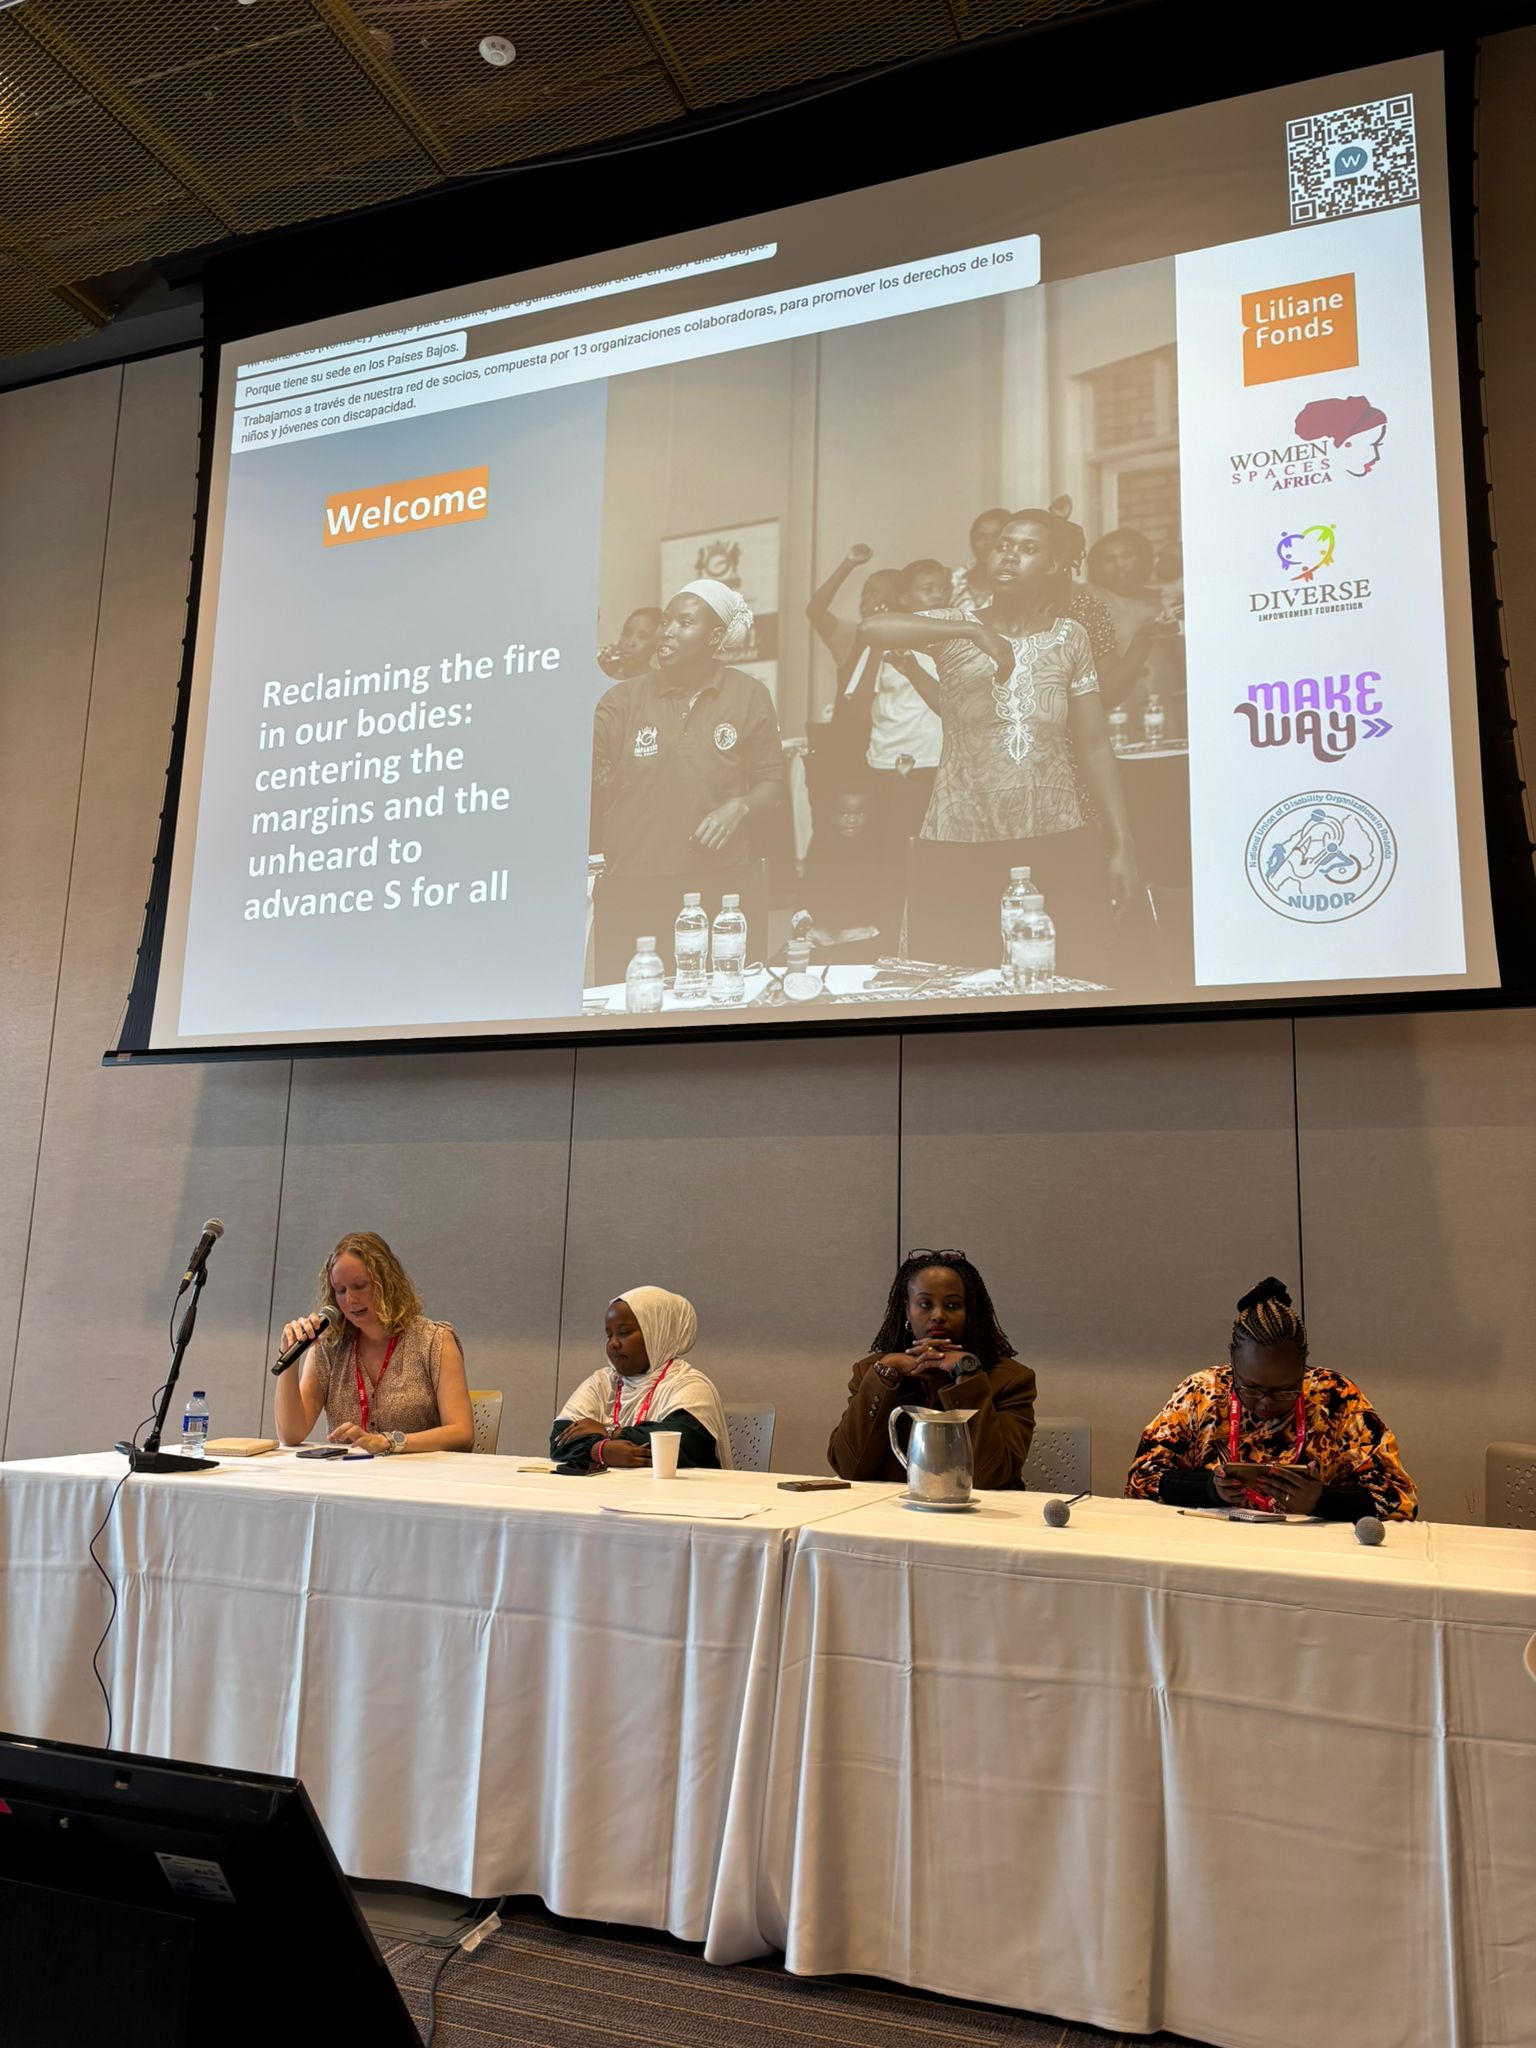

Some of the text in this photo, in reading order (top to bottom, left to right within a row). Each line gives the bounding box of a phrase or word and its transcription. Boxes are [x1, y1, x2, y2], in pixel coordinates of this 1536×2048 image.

[1255, 292, 1344, 324] Liliane
[243, 251, 1014, 427] Trabajamos a través de nuestra red de socios, compuesta por 13 organizaciones colaboradoras, para promover los derechos de los
[1256, 317, 1335, 349] Fonds
[245, 343, 459, 398] Porque tiene su sede en los Países Bajos.
[241, 398, 417, 444] niños y jóvenes con discapacidad.
[1230, 440, 1328, 471] WOMEN
[1272, 472, 1333, 491] AFRICA
[326, 484, 488, 537] Welcome
[1249, 579, 1372, 613] DIVERSE
[1258, 602, 1363, 622] EMPOWERMENT FOUNDATION
[262, 643, 561, 710] Reclaiming the fire
[258, 700, 474, 750] in our bodies:
[1233, 702, 1357, 763] WAY
[255, 743, 465, 791] centering the
[251, 782, 511, 835] margins and the
[1248, 835, 1262, 868] National
[1256, 815, 1277, 836] Union
[1283, 794, 1324, 811] Disability
[1325, 793, 1378, 822] Organizations
[248, 836, 423, 878] unheard to
[243, 870, 510, 921] advance S for all
[1288, 891, 1357, 912] NUDOR
